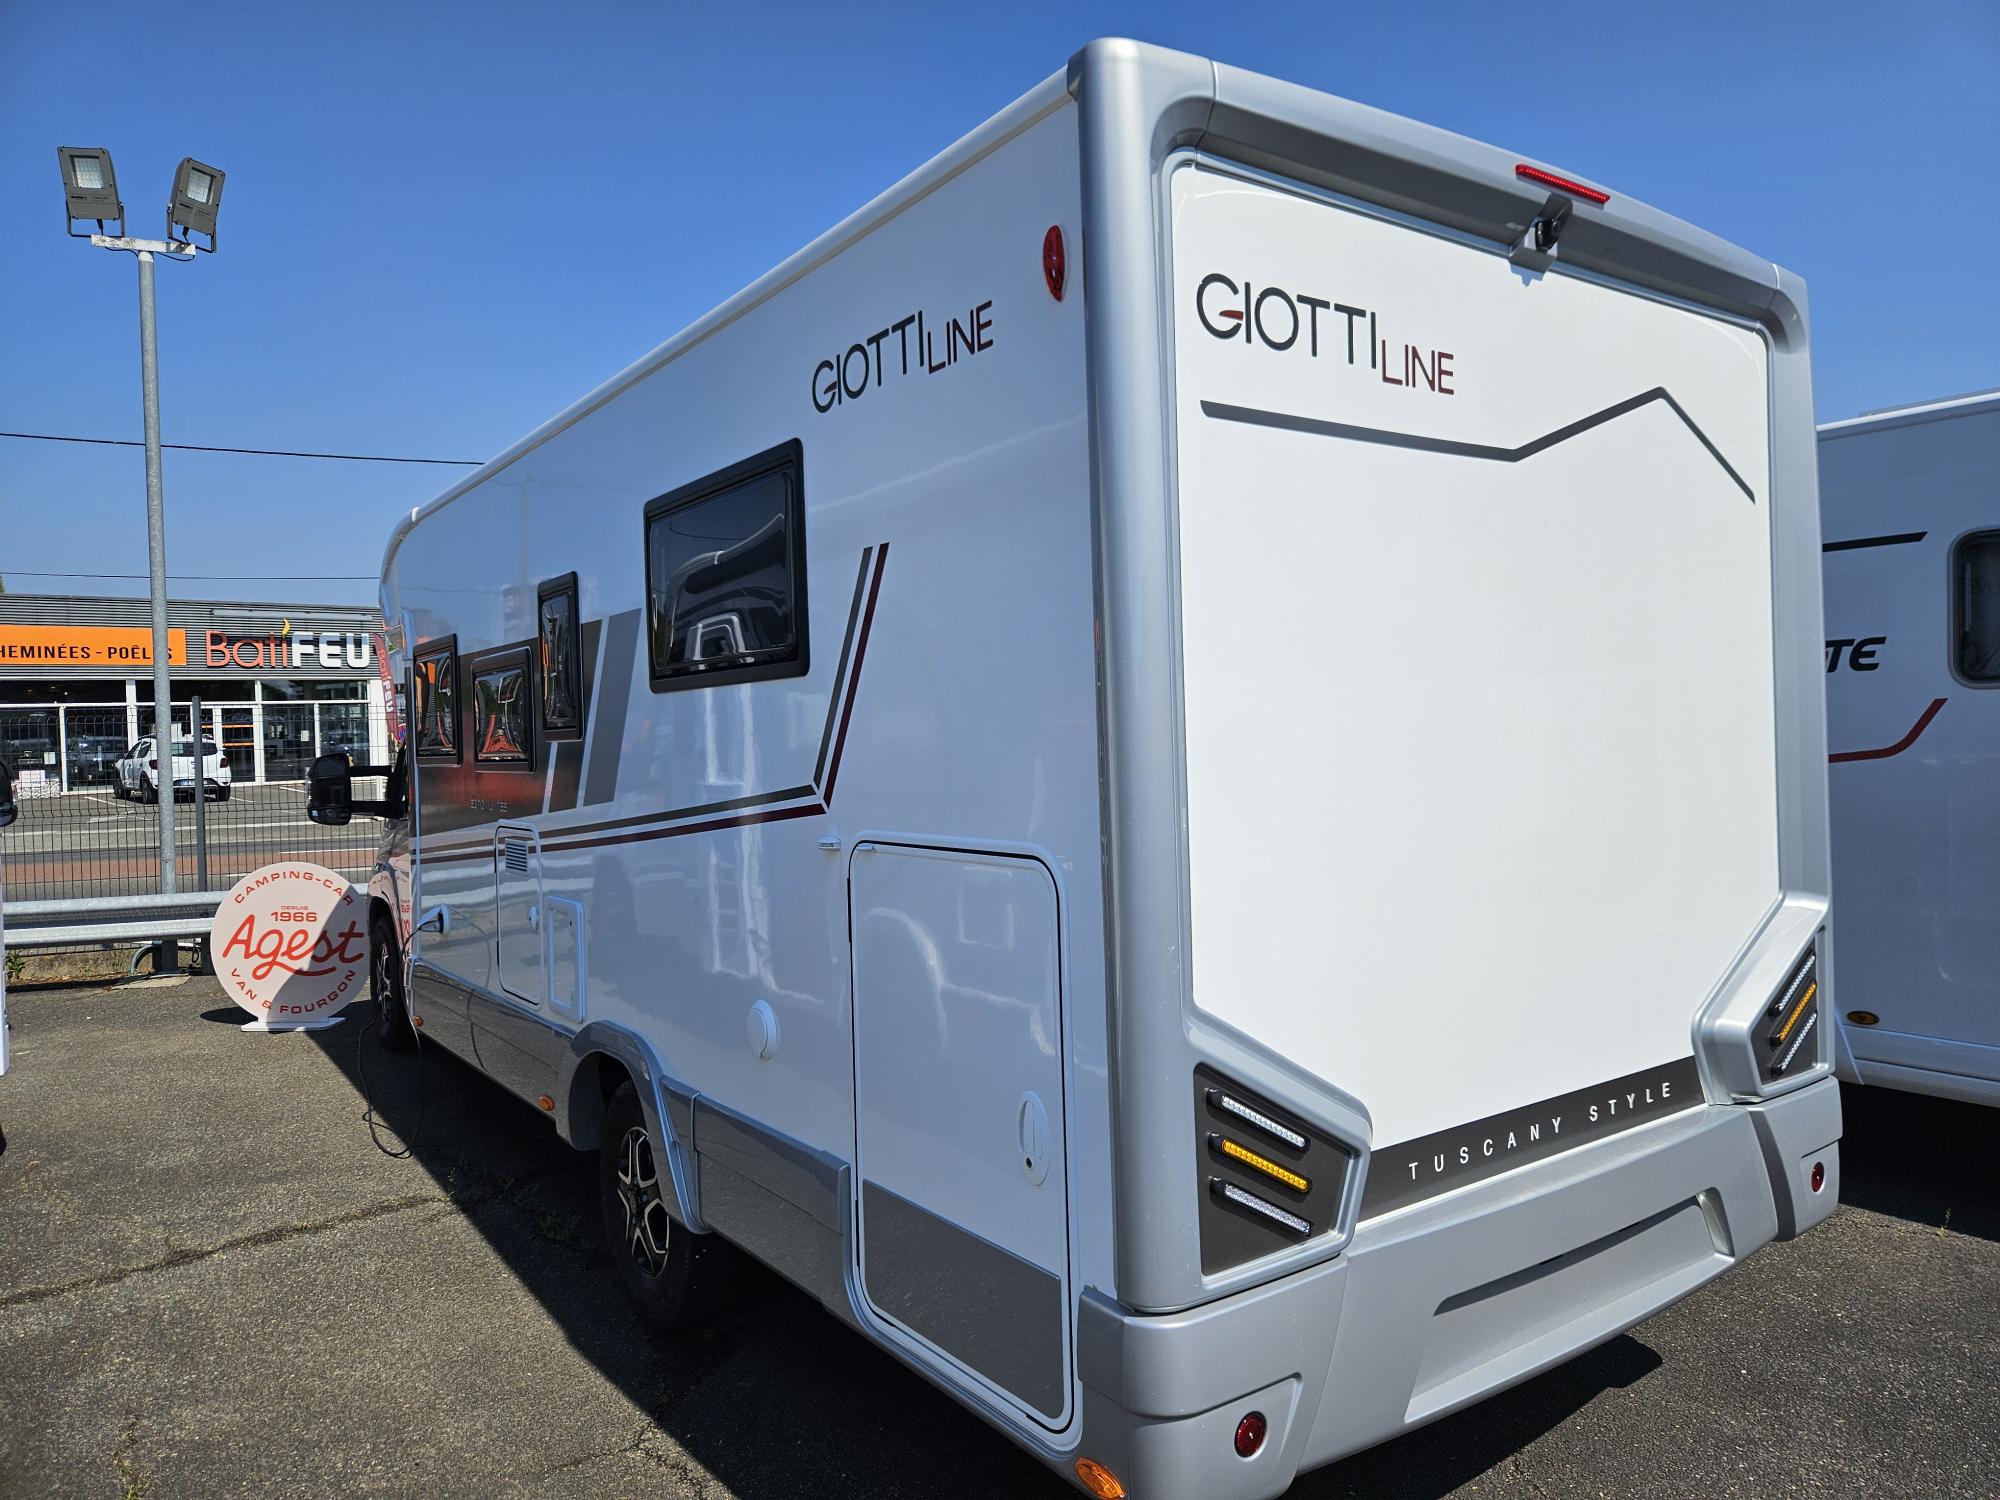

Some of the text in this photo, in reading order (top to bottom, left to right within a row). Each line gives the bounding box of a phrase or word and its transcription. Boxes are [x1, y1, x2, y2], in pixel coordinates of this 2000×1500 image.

[108, 645, 173, 660] POÊLS
[1825, 636, 1887, 673] TE
[234, 870, 354, 906] CAMPING-CAR
[270, 911, 318, 923] 1966
[222, 914, 365, 981] Agest
[231, 967, 356, 1014] VAN & FOURGON
[1408, 1082, 1671, 1180] TUSCANY STYLE
